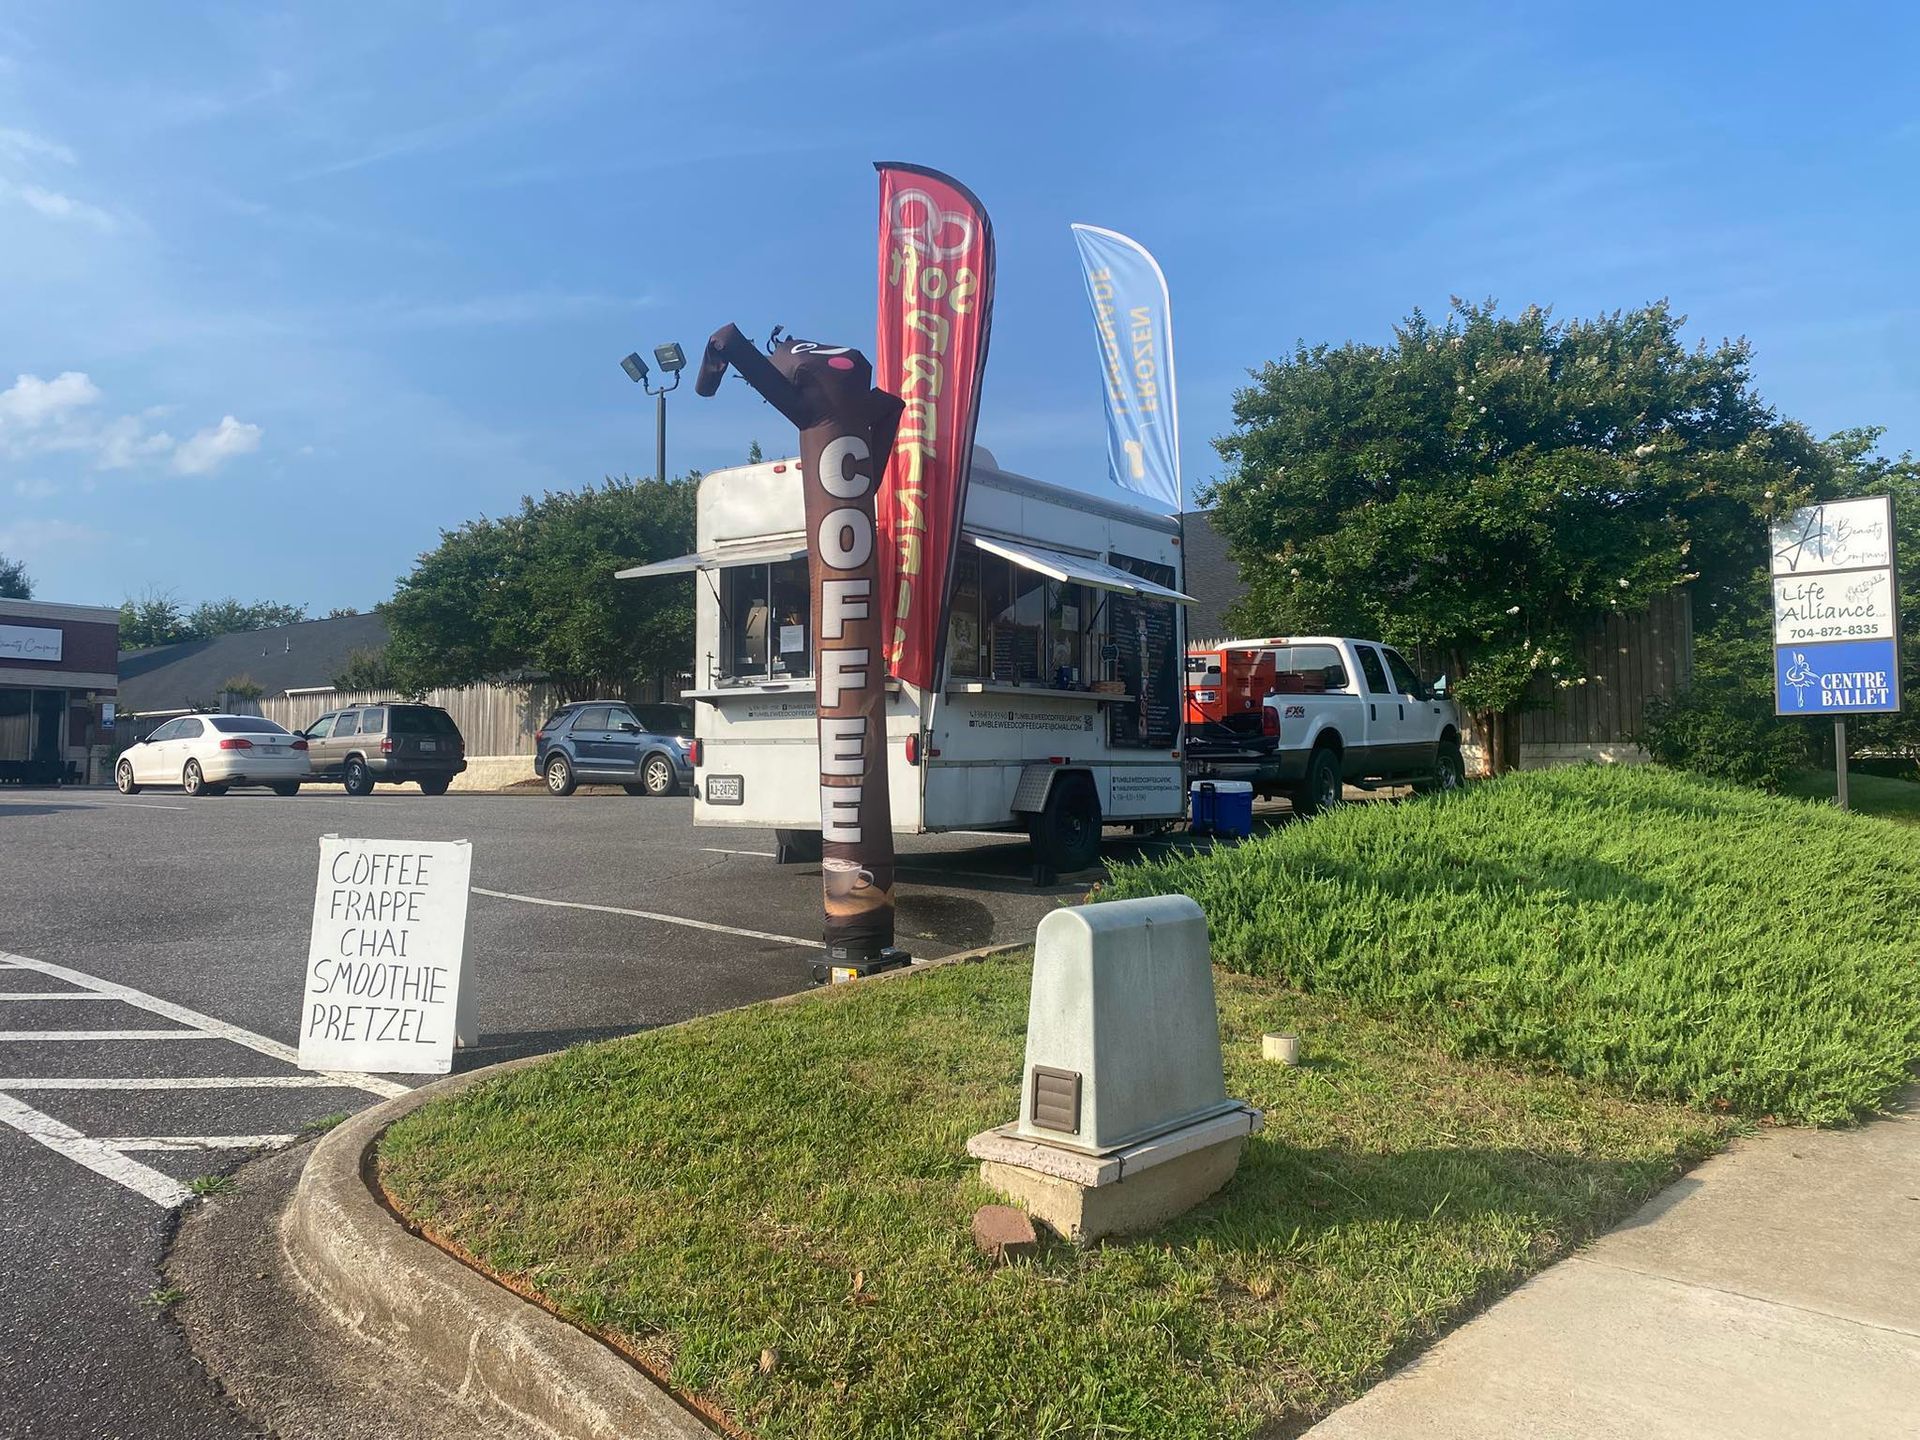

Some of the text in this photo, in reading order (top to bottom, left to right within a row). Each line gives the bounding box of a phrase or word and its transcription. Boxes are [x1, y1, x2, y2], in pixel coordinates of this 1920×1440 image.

[1774, 506, 1828, 571] A
[1837, 518, 1883, 542] Beauty
[1831, 542, 1887, 566] Company
[1782, 582, 1825, 602] Life
[1779, 603, 1876, 622] Alliance
[818, 434, 873, 843] COFFEE
[1790, 624, 1879, 639] 704-872-8335
[1820, 671, 1887, 690] CENTRE
[1822, 688, 1889, 707] BALLET
[1285, 705, 1305, 715] FX4
[331, 851, 434, 886] COFFEE
[330, 890, 426, 922] FRAPPE
[340, 928, 409, 957] CHAI
[311, 958, 448, 1004] SMOOTHIE
[308, 1004, 437, 1044] PRETZEL
